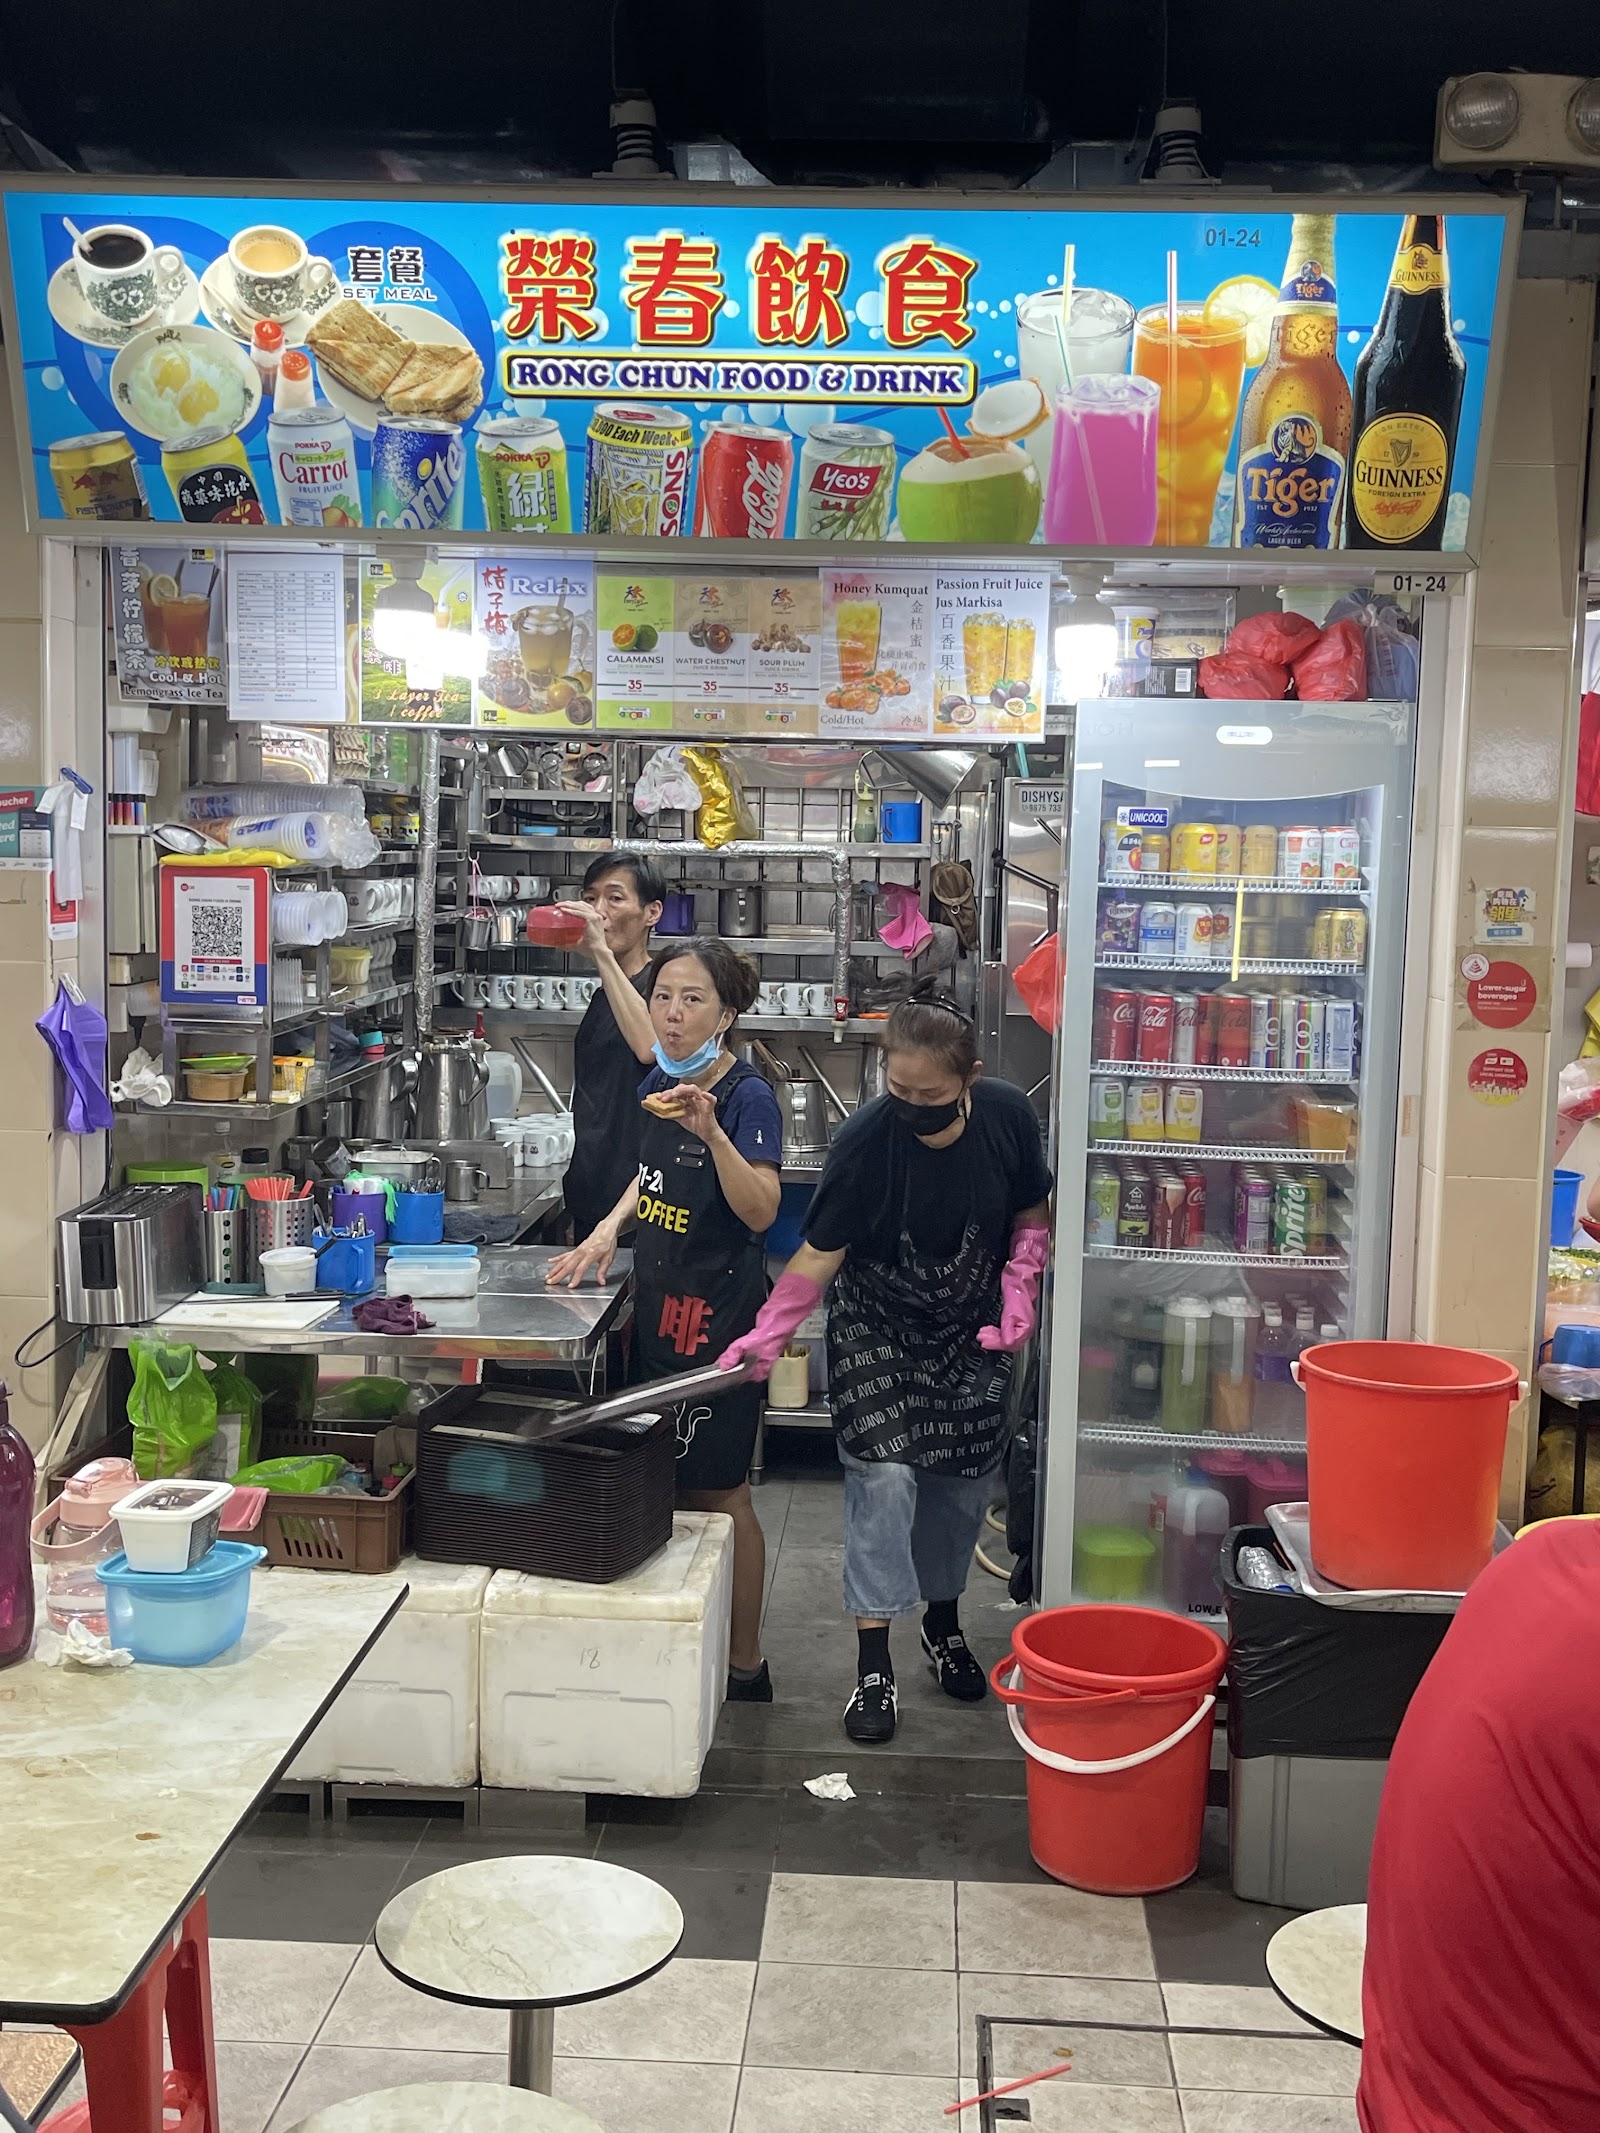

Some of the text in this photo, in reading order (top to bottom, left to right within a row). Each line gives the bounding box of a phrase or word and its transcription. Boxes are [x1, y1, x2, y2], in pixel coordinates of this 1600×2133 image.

[1205, 229, 1261, 248] 01-24
[349, 247, 424, 284] 套餐
[1395, 269, 1440, 283] GUINNESS
[343, 288, 437, 301] SET MEAL
[505, 233, 977, 348] 榮春飲食
[1296, 281, 1325, 298] Tiger
[517, 362, 963, 393] RONG CHUN FOOD & DRINK
[612, 425, 672, 446] Each Week
[495, 452, 533, 463] POKKA
[279, 452, 349, 485] Carrot
[1356, 460, 1444, 488] GUINNESS
[298, 483, 343, 494] FRUIT JUICE
[1248, 466, 1336, 518] Tiger
[1368, 489, 1426, 498] FOREIGN EXTRA
[511, 577, 588, 596] Relax
[834, 582, 929, 598] Honey Kumquat
[936, 578, 1043, 591] Passion Fruit Juice
[935, 596, 1003, 609] Jus Markisa
[910, 600, 924, 648] 金桔蜜
[606, 655, 664, 664] CALAMANSI
[939, 613, 955, 691] 百香果汁
[675, 658, 746, 667] WATER CHESTNUT
[759, 659, 781, 667] SOUR
[149, 670, 223, 684] Cool & Hot
[124, 684, 224, 699] Lemongrass Ice Tea
[627, 680, 642, 690] 35
[703, 681, 717, 691] 35
[774, 683, 789, 693] 35
[373, 688, 461, 704] 3 Layer Tea
[400, 704, 444, 721] coffee
[820, 714, 864, 725] Cold/Hot
[1029, 804, 1047, 812] 9675
[1130, 812, 1165, 823] UNICOOL
[1478, 984, 1527, 993] Lower-sugar
[1478, 992, 1517, 1001] beverages
[1295, 1019, 1313, 1055] 100
[658, 1294, 714, 1356] 啡
[853, 1345, 895, 1367] AVEC TOI
[857, 1375, 894, 1399] AVEC TOI
[885, 1404, 900, 1420] TU
[923, 1422, 935, 1436] LA
[873, 1442, 889, 1459] TA
